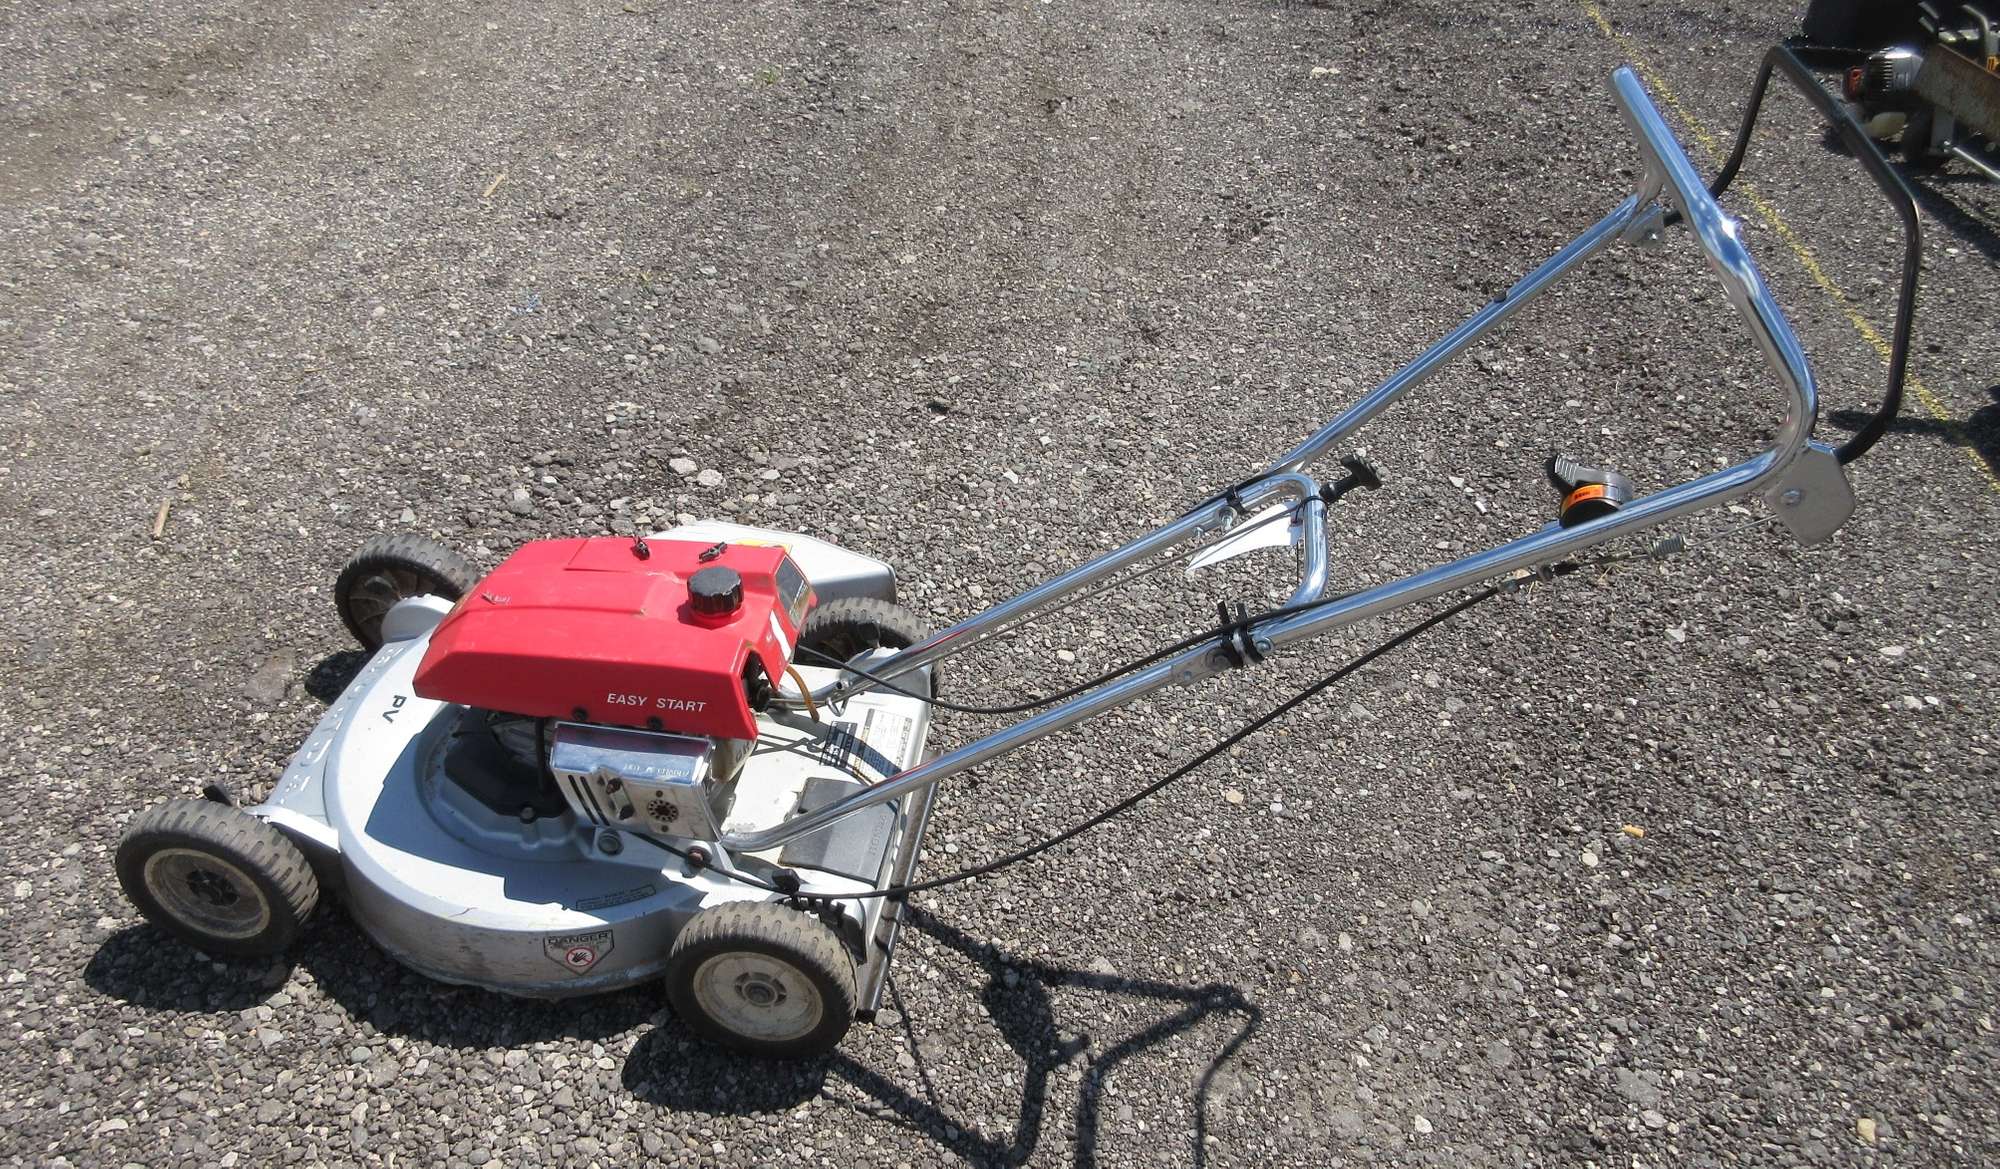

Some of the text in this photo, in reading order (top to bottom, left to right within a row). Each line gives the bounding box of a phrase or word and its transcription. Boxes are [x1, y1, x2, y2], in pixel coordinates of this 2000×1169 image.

[382, 694, 407, 724] PV
[607, 693, 707, 713] EASY START
[547, 931, 608, 945] DANGER
